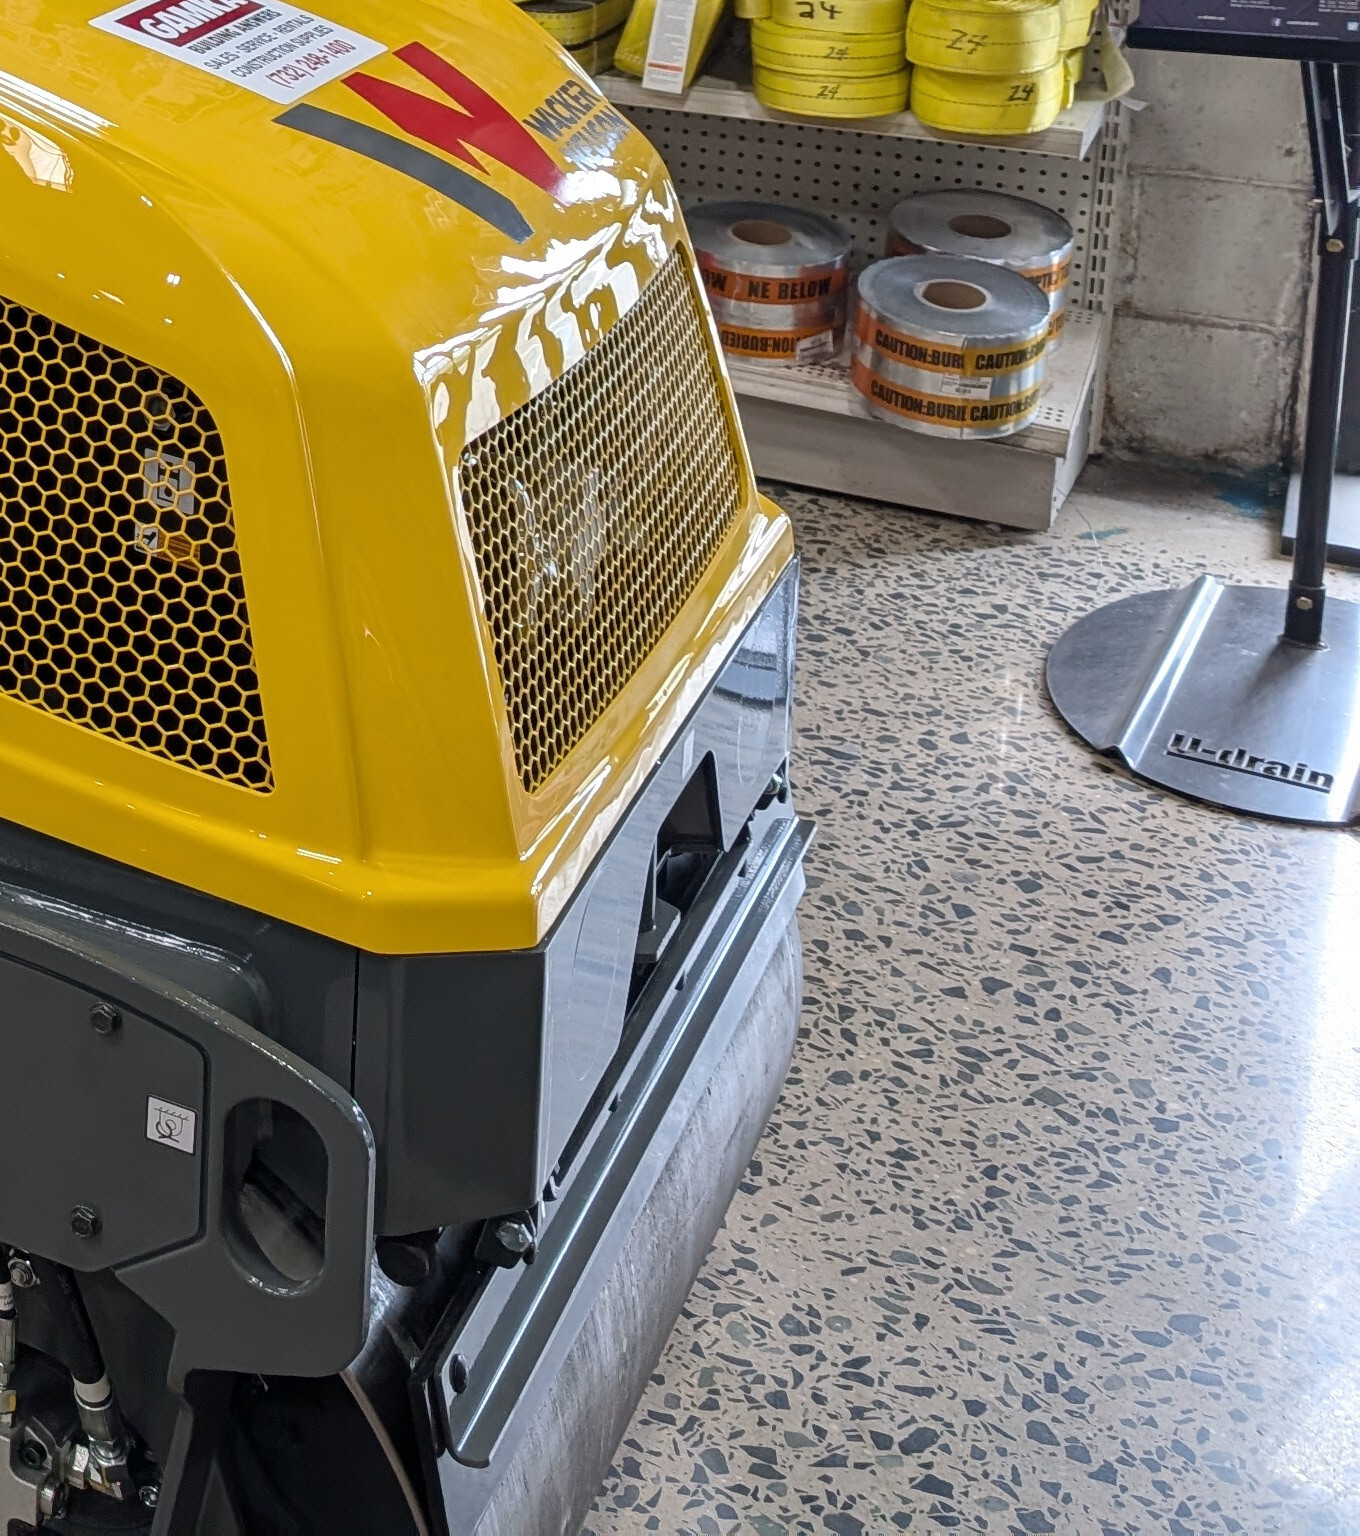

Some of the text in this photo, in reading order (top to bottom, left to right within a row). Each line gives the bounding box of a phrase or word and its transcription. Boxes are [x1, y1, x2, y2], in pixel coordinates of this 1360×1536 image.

[187, 8, 283, 55] BUILDING ANSWERS
[795, 0, 843, 21] 24
[204, 14, 315, 70] SALES SERVICE RENTALS
[231, 24, 335, 78] CONSTRUCTION SUPPLIES
[265, 39, 357, 90] (732) 248-1400
[521, 79, 601, 142] WACKER
[778, 275, 832, 301] BELOW
